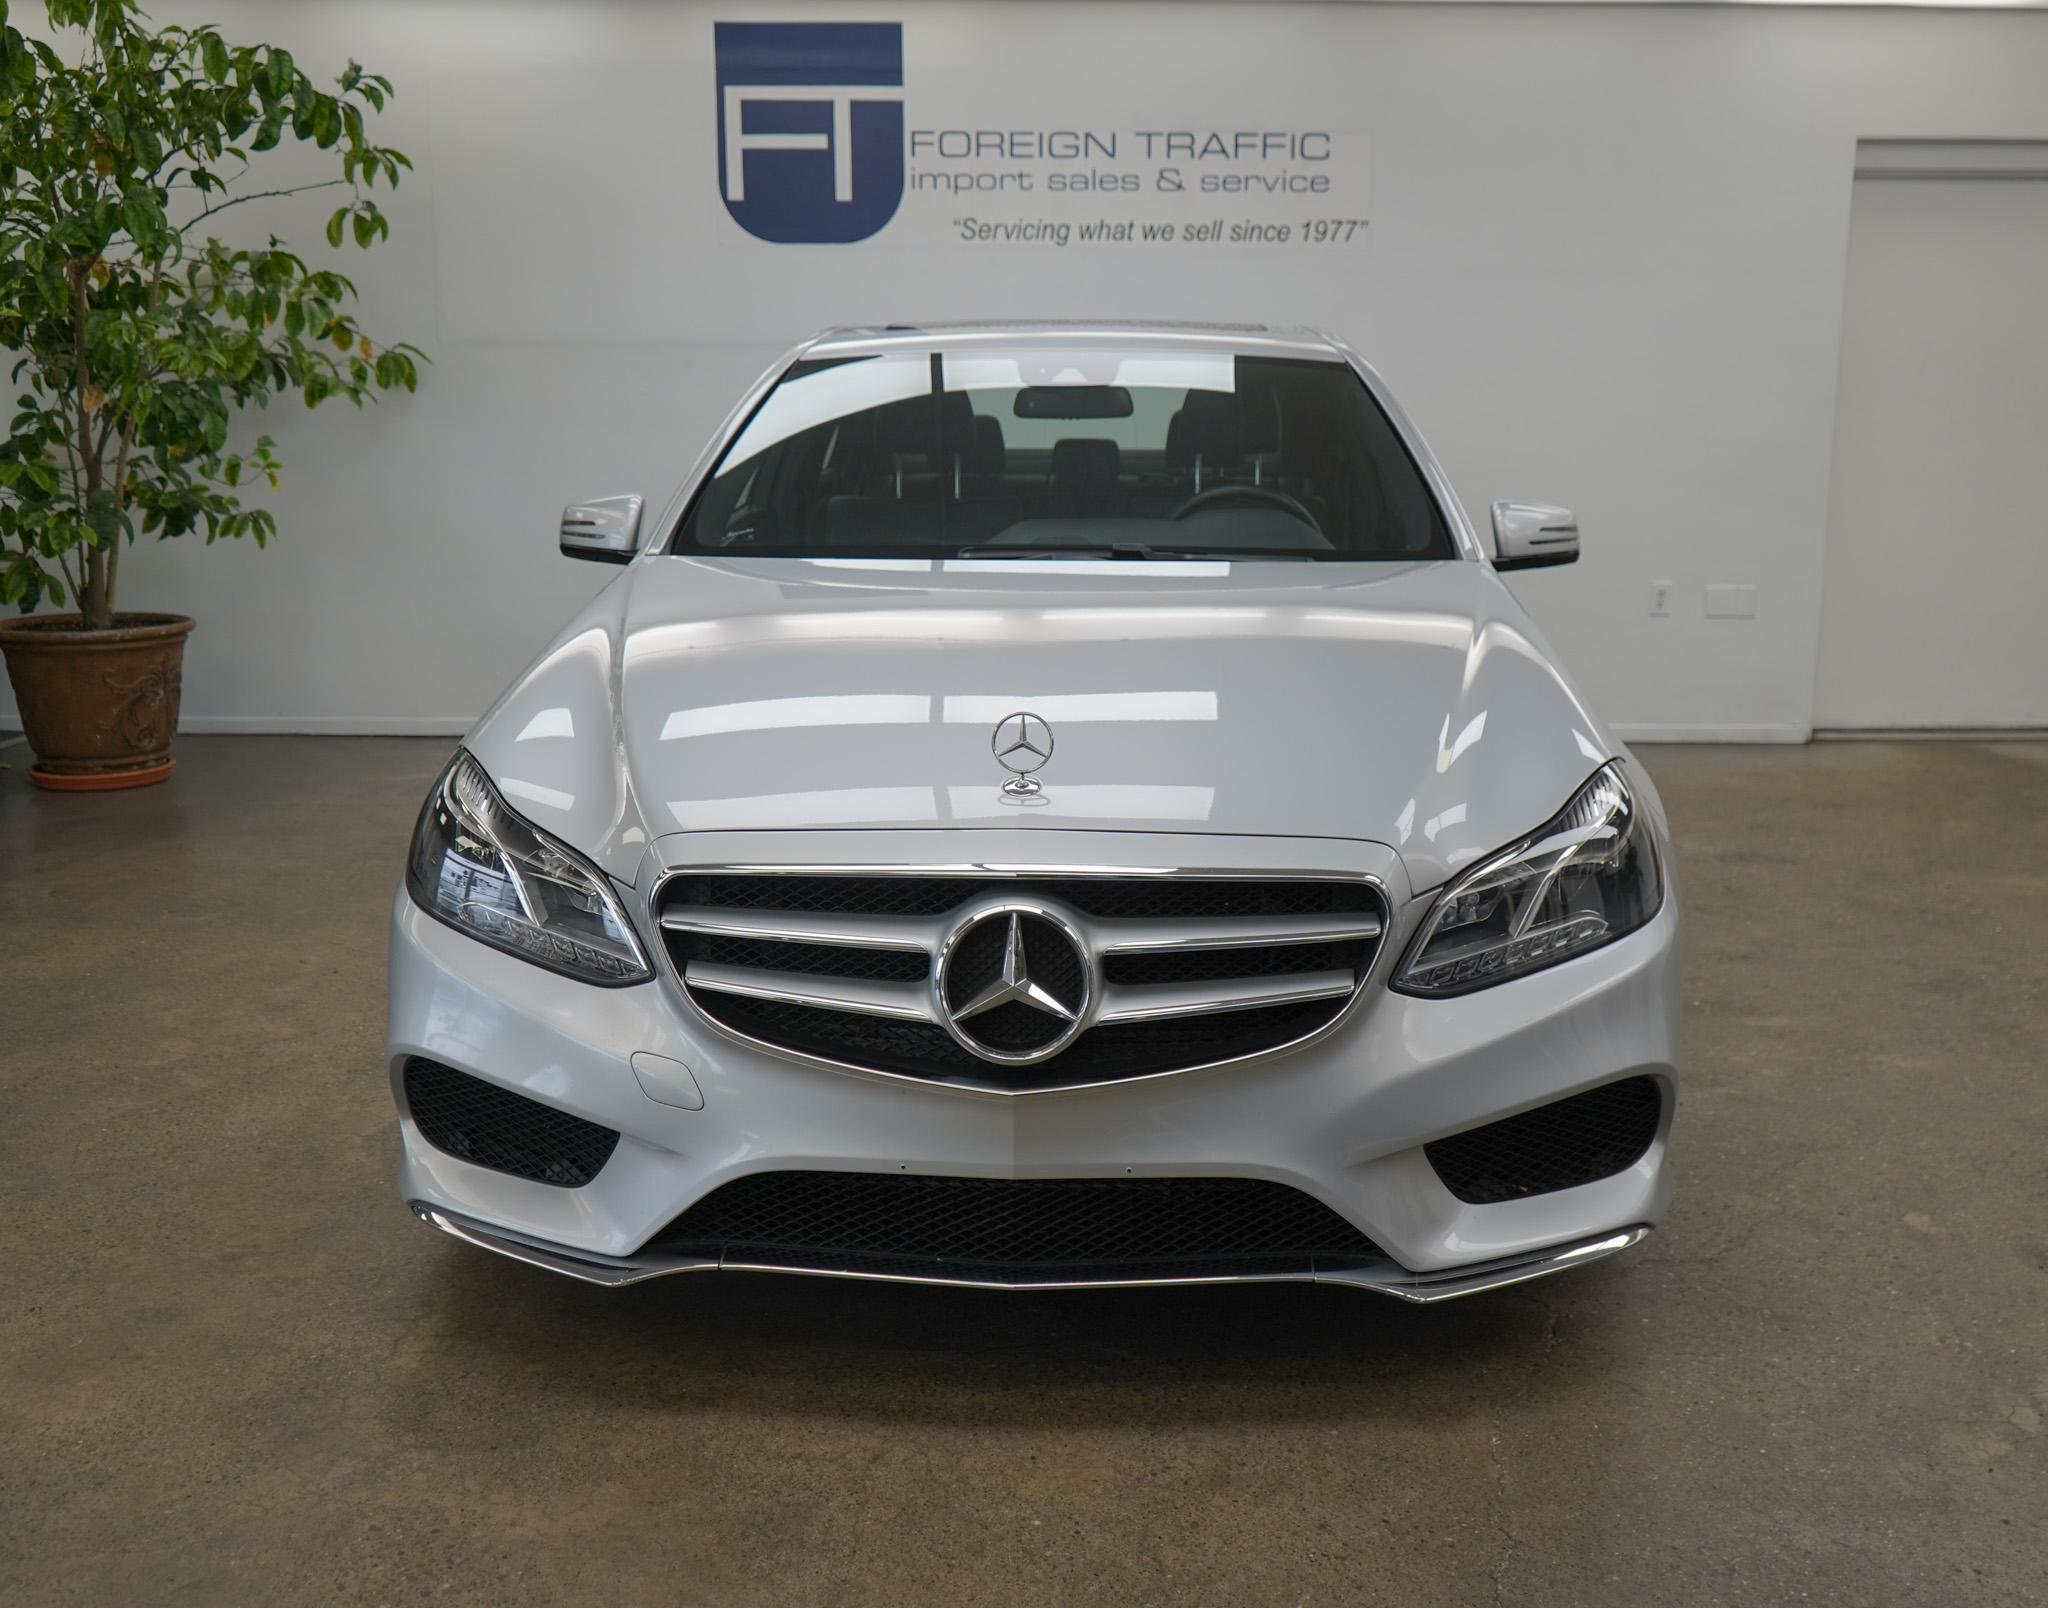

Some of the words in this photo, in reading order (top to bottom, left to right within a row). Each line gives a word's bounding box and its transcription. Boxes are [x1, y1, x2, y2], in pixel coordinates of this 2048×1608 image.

[911, 131, 1116, 160] FOREIGN
[1136, 131, 1331, 161] TRAFFIC
[911, 168, 1033, 195] import
[1048, 168, 1140, 192] sales
[1156, 168, 1186, 192] &
[1200, 168, 1330, 193] service
[1078, 219, 1135, 242] what
[1141, 224, 1175, 242] we
[1182, 219, 1224, 242] sell
[1229, 219, 1292, 243] since
